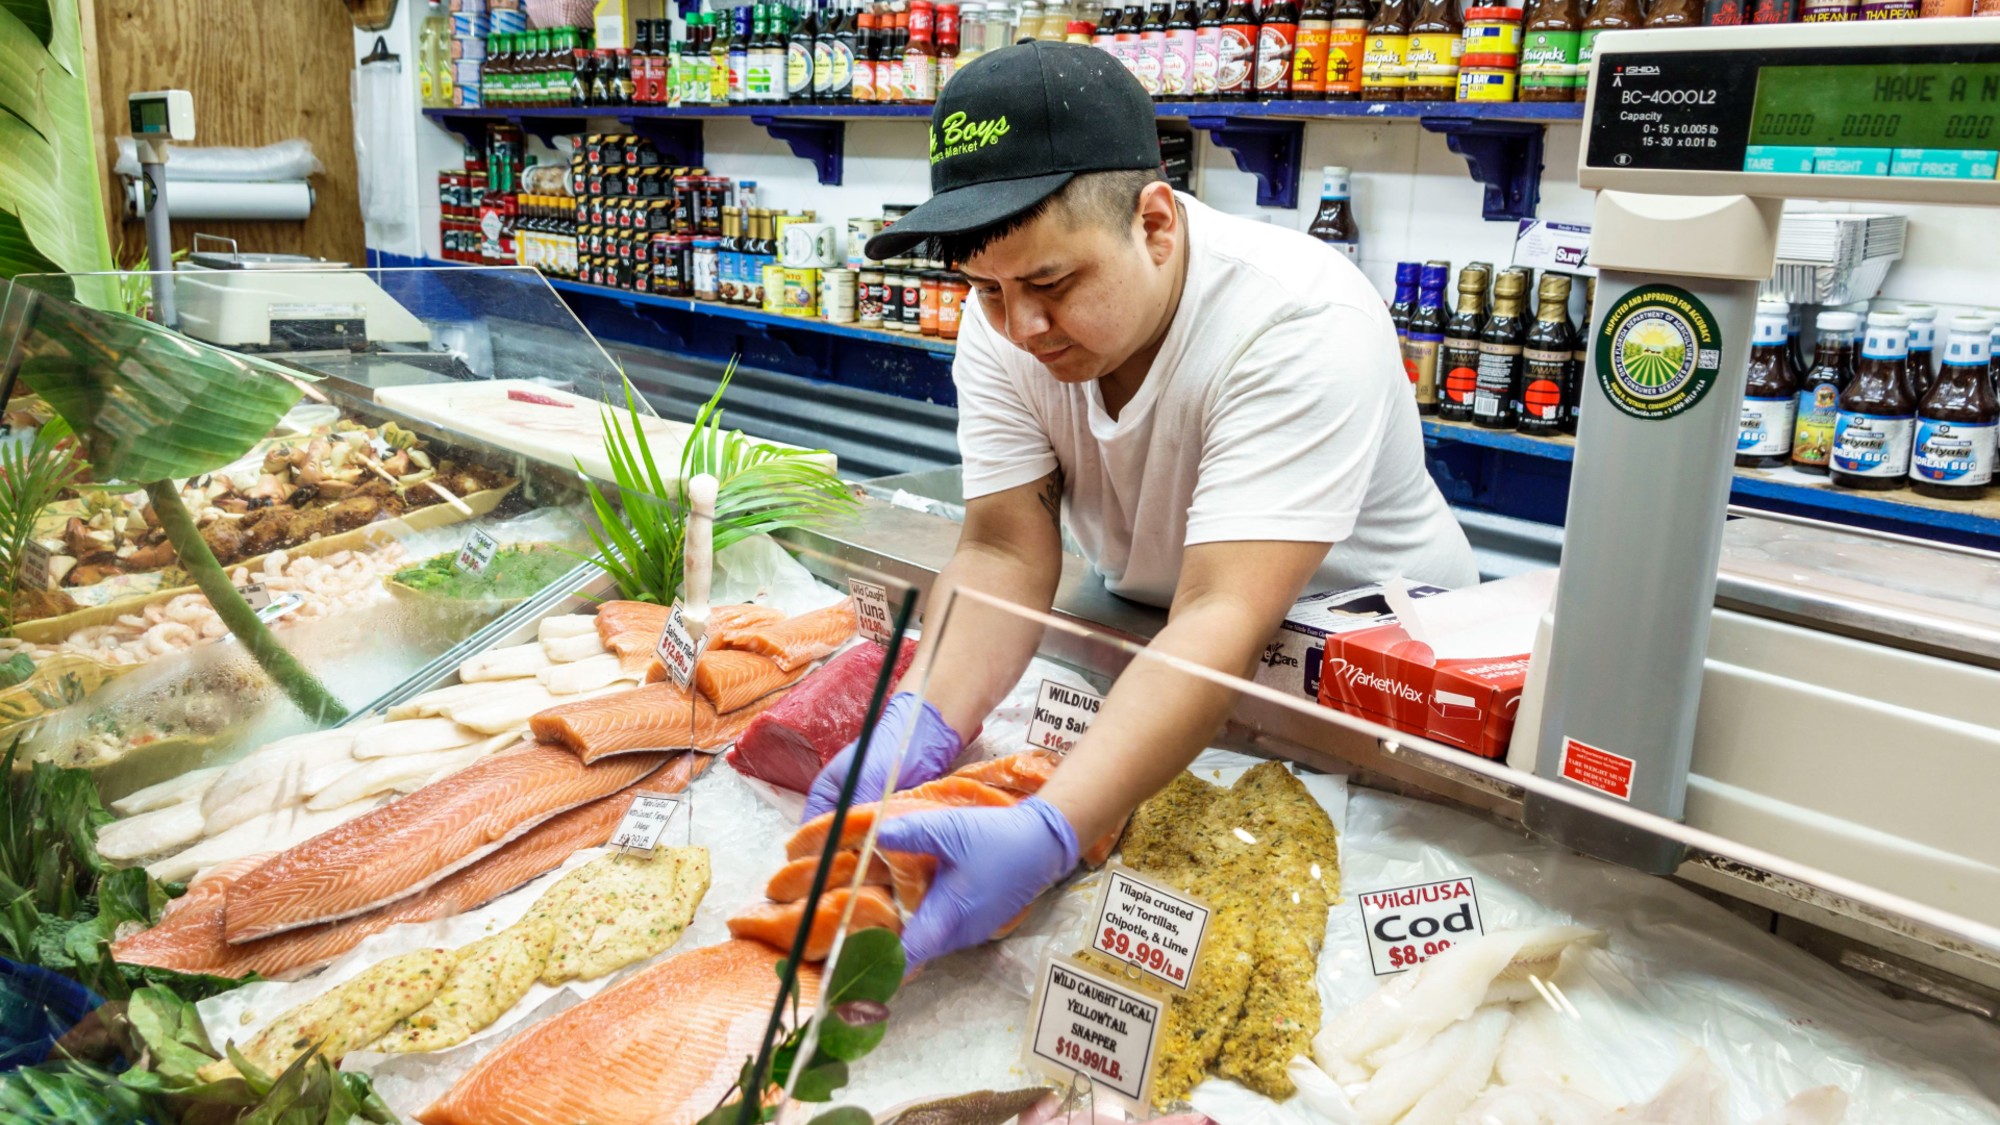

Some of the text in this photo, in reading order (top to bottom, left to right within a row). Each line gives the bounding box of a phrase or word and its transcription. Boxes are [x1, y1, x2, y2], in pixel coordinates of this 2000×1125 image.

[1866, 9, 1919, 20] THAI PEAN
[1474, 74, 1490, 84] BAY
[1625, 66, 1660, 75] ISHIDA
[1874, 76, 1936, 102] HAVE
[1950, 76, 1966, 102] A
[1620, 111, 1662, 122] Capacity
[942, 111, 1010, 147] Boys
[1643, 124, 1650, 133] 0
[1658, 124, 1670, 134] 15
[1673, 126, 1680, 134] x
[1681, 124, 1708, 134] 0.005
[1709, 124, 1719, 134] lb
[945, 140, 978, 158] Market
[1642, 137, 1654, 146] 15
[1661, 137, 1674, 146] 30
[1677, 139, 1683, 147] x
[1684, 138, 1705, 147] 0.01
[1707, 138, 1717, 147] lb
[1747, 158, 1775, 170] TARE
[1801, 159, 1812, 171] lb
[1817, 160, 1863, 172] WEIGHT
[1875, 161, 1887, 174] lb
[1892, 161, 1959, 176] UNIT PRICE
[1605, 292, 1712, 343] INSPECTED AND APPROVED FOR ACCURACY
[1615, 329, 1628, 357] FLORIDA
[1627, 312, 1664, 329] DEPARTMENT
[1674, 319, 1693, 361] AGRICULTURE
[1616, 363, 1688, 395] AND CONSUMER SERVICES
[1648, 392, 1687, 410] COMMISSIONER
[1921, 443, 1971, 457] Teriyaki
[864, 586, 885, 602] Caught
[856, 597, 886, 621] Tuna
[666, 624, 684, 650] Salmon
[1306, 628, 1318, 636] Exam
[1329, 658, 1423, 704] MarketWax
[1034, 707, 1063, 730] King
[1568, 757, 1627, 783] TARE WEIGHT MUST
[1574, 767, 1583, 776] BE
[1583, 770, 1617, 787] DEDUCTED
[1120, 881, 1194, 921] Tilapia crusted
[1122, 902, 1179, 936] w/ Tortillas,
[1374, 903, 1474, 943] Cod
[1105, 912, 1189, 956] Chipotle, & Lime
[1101, 927, 1185, 981] $9.99/LB
[1053, 971, 1152, 1024] WILD CAUGHT LOCAL
[1067, 998, 1128, 1036] YELLOWTAIL
[1071, 1022, 1118, 1053] SNAPPER
[1056, 1036, 1123, 1082] $19.99/LB.
